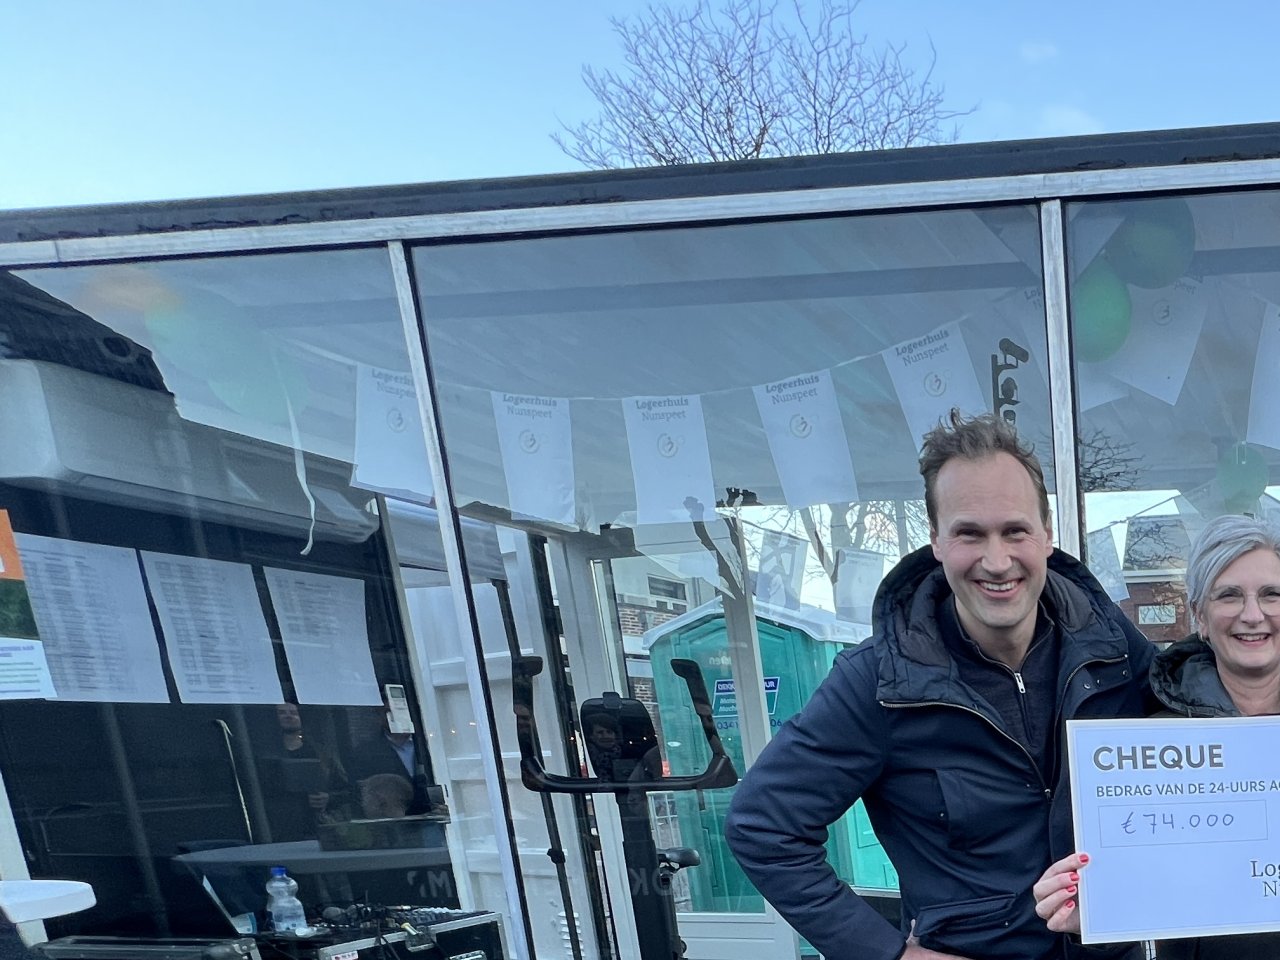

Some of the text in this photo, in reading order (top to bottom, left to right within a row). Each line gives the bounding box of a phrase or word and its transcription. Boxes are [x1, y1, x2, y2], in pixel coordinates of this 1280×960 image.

[895, 329, 950, 356] Logeerhuis
[902, 342, 950, 366] Nunspeet
[765, 374, 820, 394] Logeerhuis
[503, 393, 557, 407] Logeerhuis
[635, 397, 689, 410] Logeerhuis
[772, 387, 818, 405] Nunspeet
[507, 407, 552, 419] Nunspeet
[642, 409, 686, 422] Nunspeet
[1093, 744, 1224, 772] CHEQUE
[1096, 784, 1152, 797] BEDRAG
[1156, 783, 1184, 796] VAN
[1189, 783, 1205, 794] DE
[1209, 780, 1266, 794] 24-UURS
